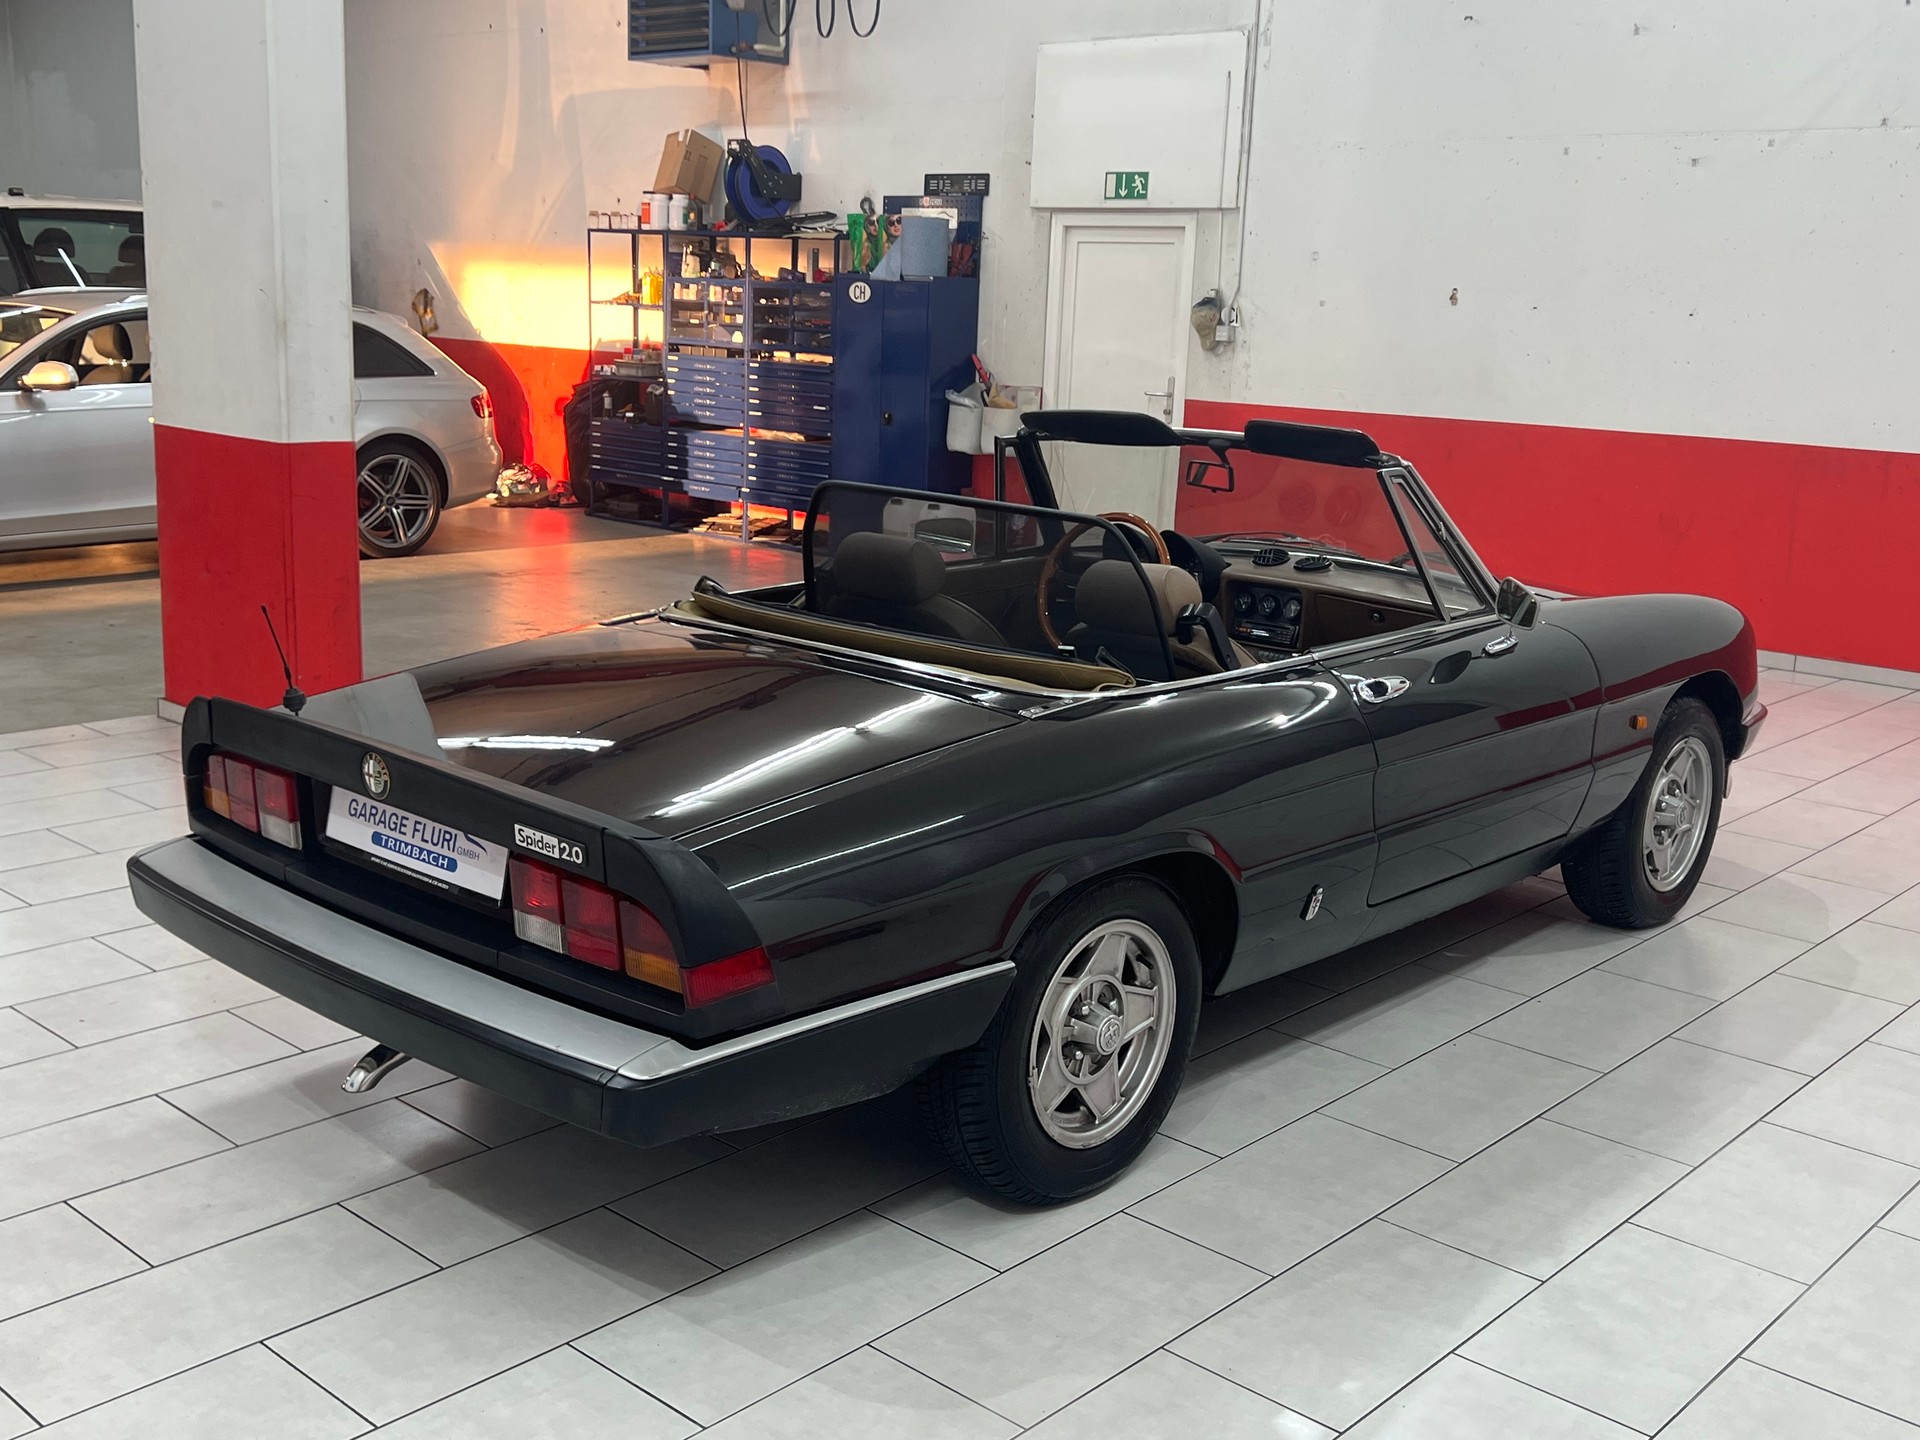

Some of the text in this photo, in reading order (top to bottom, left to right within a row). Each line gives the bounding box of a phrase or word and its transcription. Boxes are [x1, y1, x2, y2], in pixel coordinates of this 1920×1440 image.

[853, 284, 866, 300] CH
[348, 798, 480, 861] GARAGE FLURI GMBH
[517, 827, 583, 864] Spider 2.0
[380, 834, 449, 869] TRIMBACH
